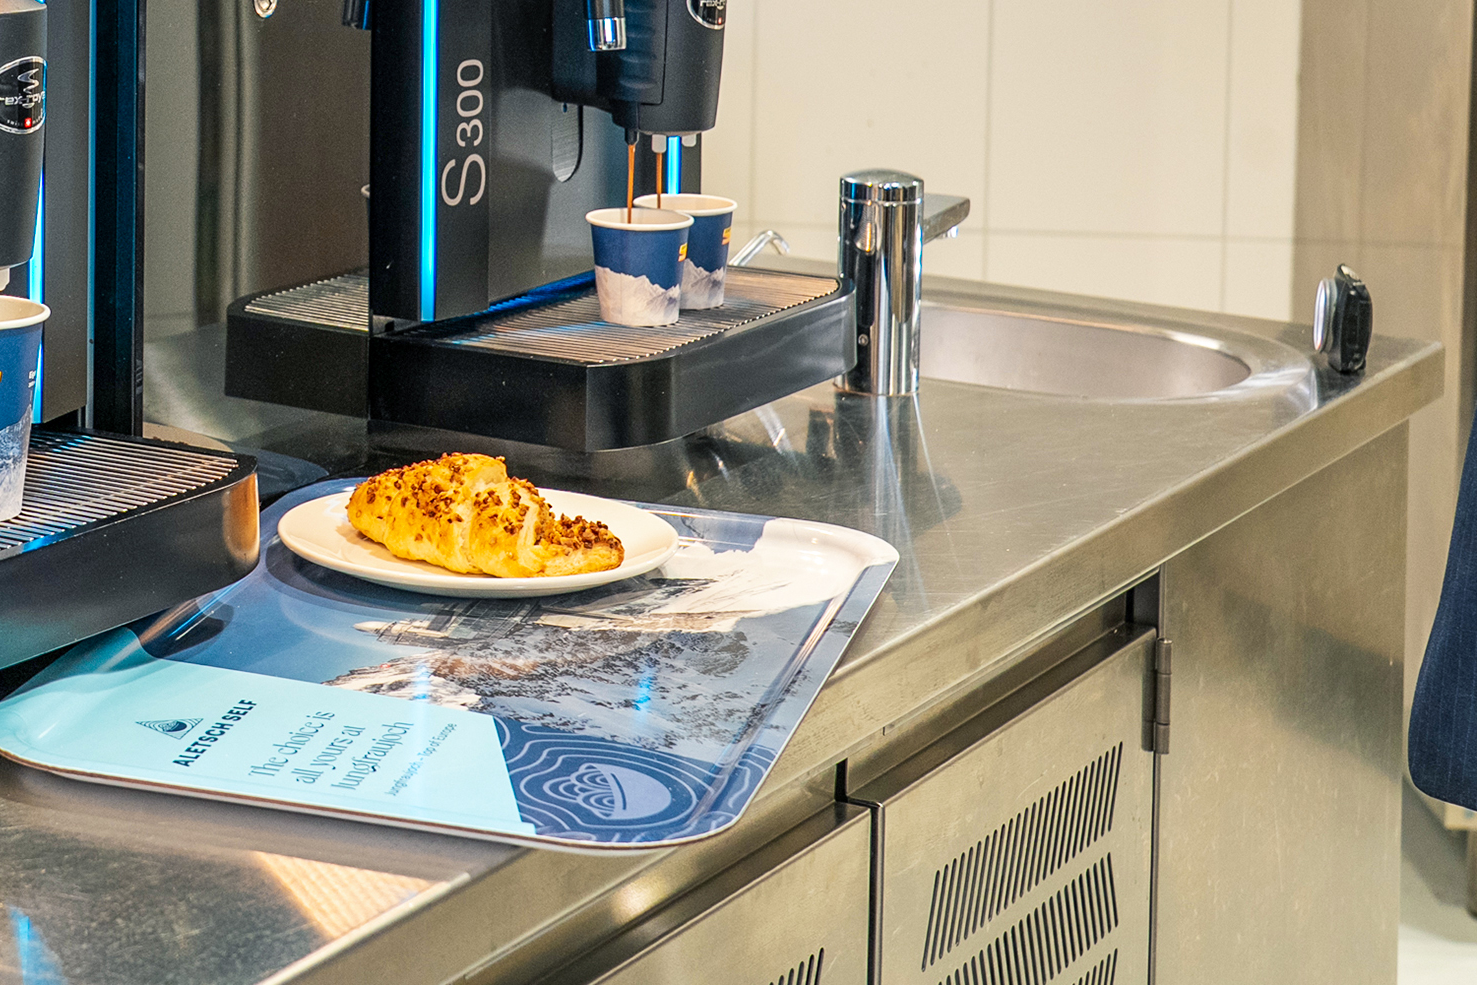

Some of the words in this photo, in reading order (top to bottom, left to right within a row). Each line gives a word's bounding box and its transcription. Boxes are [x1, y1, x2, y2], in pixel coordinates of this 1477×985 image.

[441, 59, 486, 206] S300
[172, 722, 234, 767] ALETSCH
[221, 699, 257, 722] SELF
[248, 757, 289, 777] The
[273, 721, 324, 756] choice
[306, 711, 335, 721] is
[291, 768, 324, 785] all
[310, 737, 354, 771] yours
[341, 725, 366, 737] at
[331, 721, 414, 790] Jungfraujoch
[417, 747, 437, 756] Top
